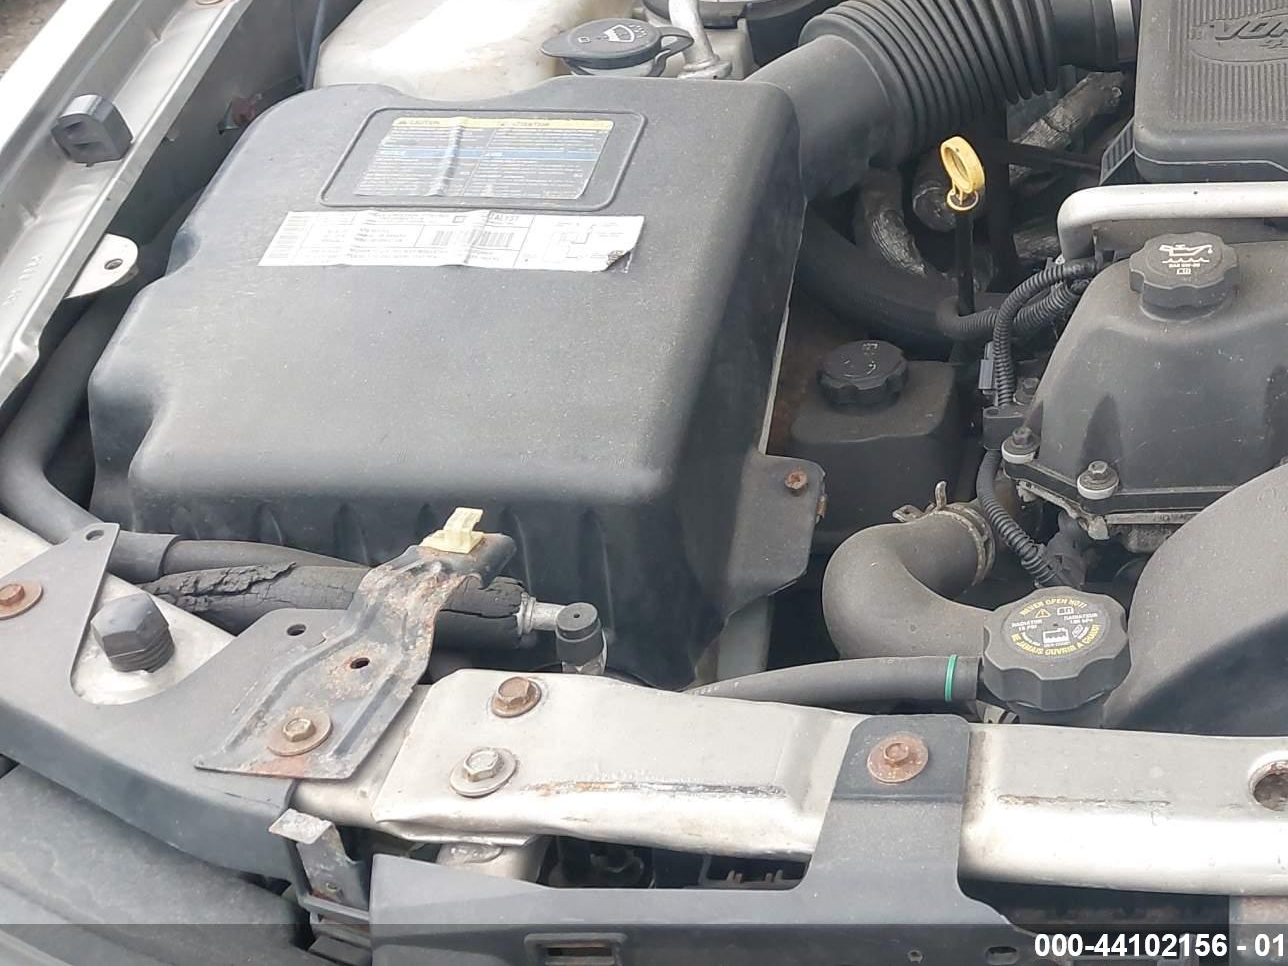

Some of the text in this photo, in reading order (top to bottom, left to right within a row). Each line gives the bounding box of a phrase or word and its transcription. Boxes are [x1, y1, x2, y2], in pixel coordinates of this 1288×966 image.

[1019, 601, 1045, 616] NEVER
[1045, 598, 1068, 607] OPEN
[1044, 644, 1077, 656] OUVRIR
